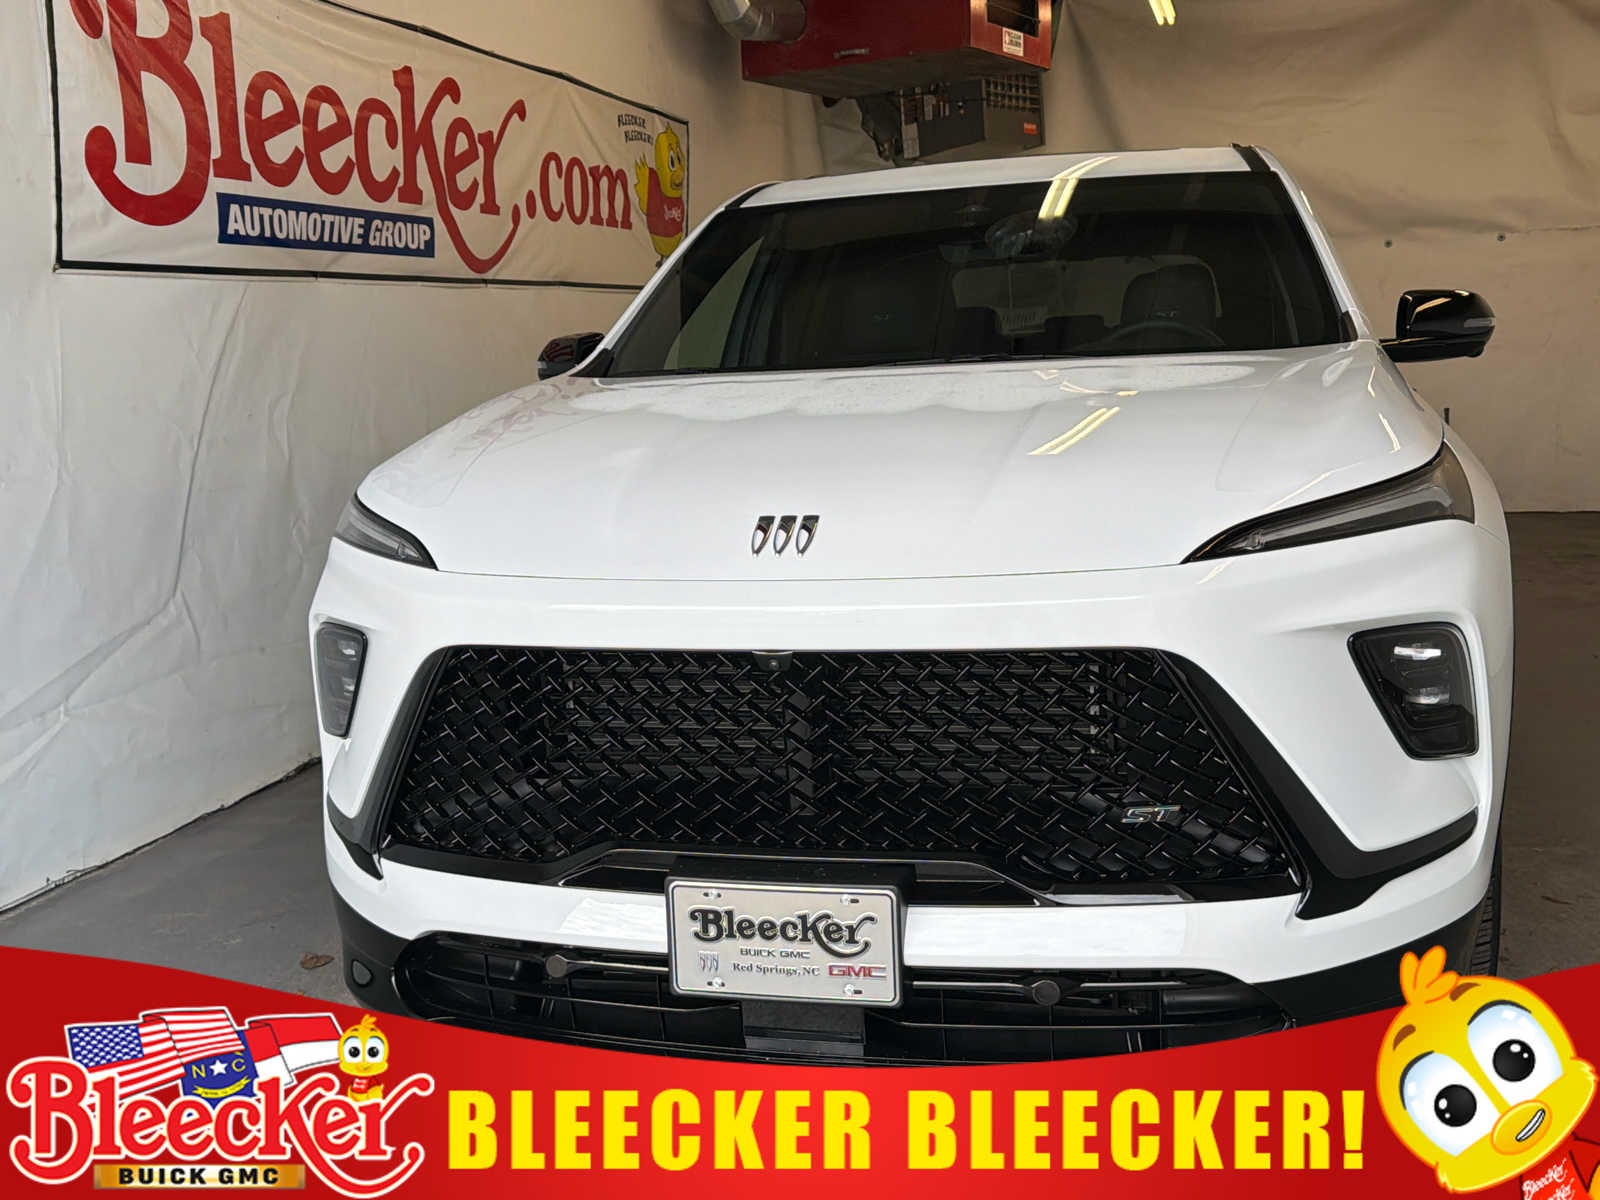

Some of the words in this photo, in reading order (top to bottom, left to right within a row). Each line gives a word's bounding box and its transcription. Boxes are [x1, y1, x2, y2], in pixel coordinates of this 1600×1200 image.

[226, 203, 365, 245] AUTOMOTIVE
[368, 218, 432, 250] GROUP
[1121, 804, 1181, 823] ST
[689, 905, 878, 958] Bleecker
[740, 948, 776, 958] BUICK
[780, 950, 811, 959] GMC
[732, 963, 753, 973] Red
[755, 965, 800, 977] Springs,
[802, 967, 821, 976] NC
[828, 964, 887, 978] GMC
